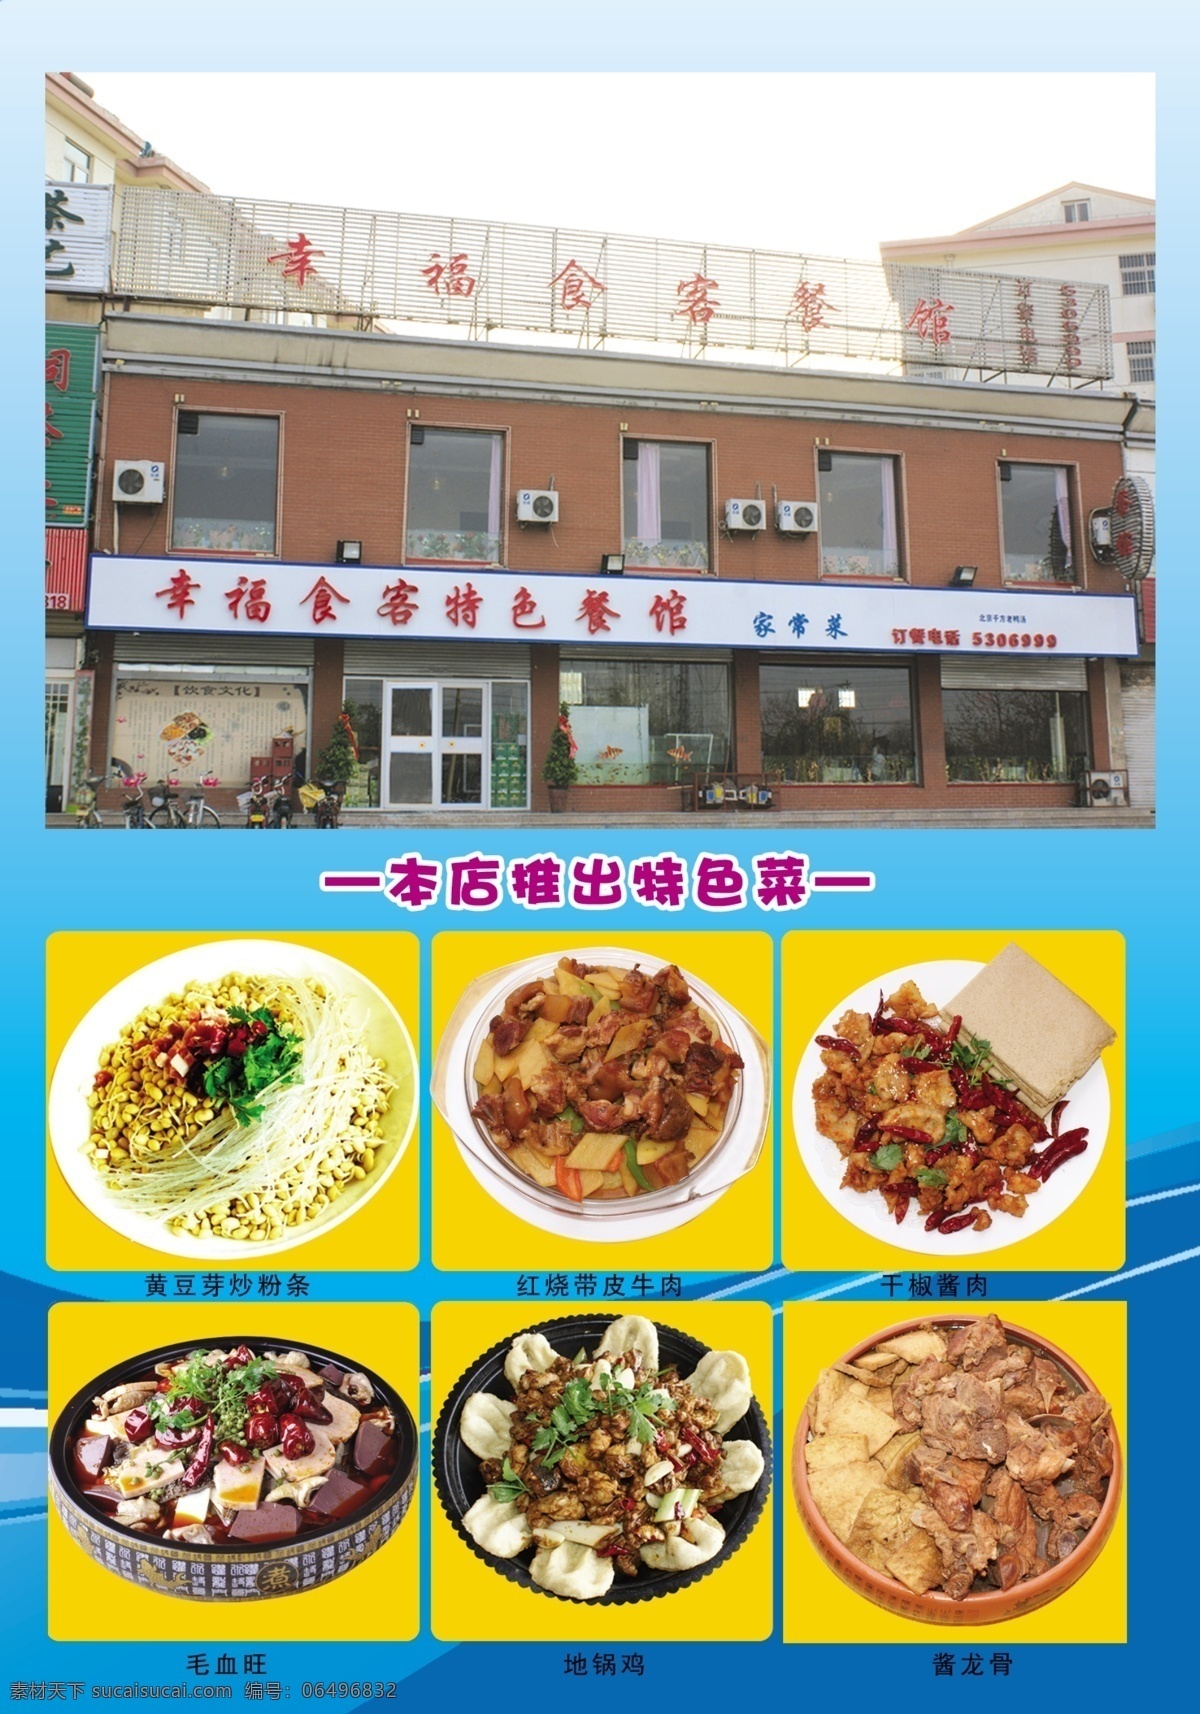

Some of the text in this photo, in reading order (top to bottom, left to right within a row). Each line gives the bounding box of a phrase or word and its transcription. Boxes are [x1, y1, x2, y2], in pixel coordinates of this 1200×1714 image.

[267, 232, 955, 345] 幸福食客餐馆
[155, 568, 688, 636] 幸福食客特色餐馆
[753, 611, 848, 640] 家常菜
[892, 628, 1057, 648] 订餐电话 5306999
[144, 1273, 311, 1297] 黄豆芽炒粉条
[517, 1273, 682, 1297] 红烧带皮牛肉
[880, 1273, 987, 1297] 干椒酱肉
[262, 1565, 291, 1591] 煮
[186, 1653, 268, 1676] 毛血旺
[564, 1652, 645, 1676] 地锅鸡
[932, 1652, 1013, 1676] 酱龙骨
